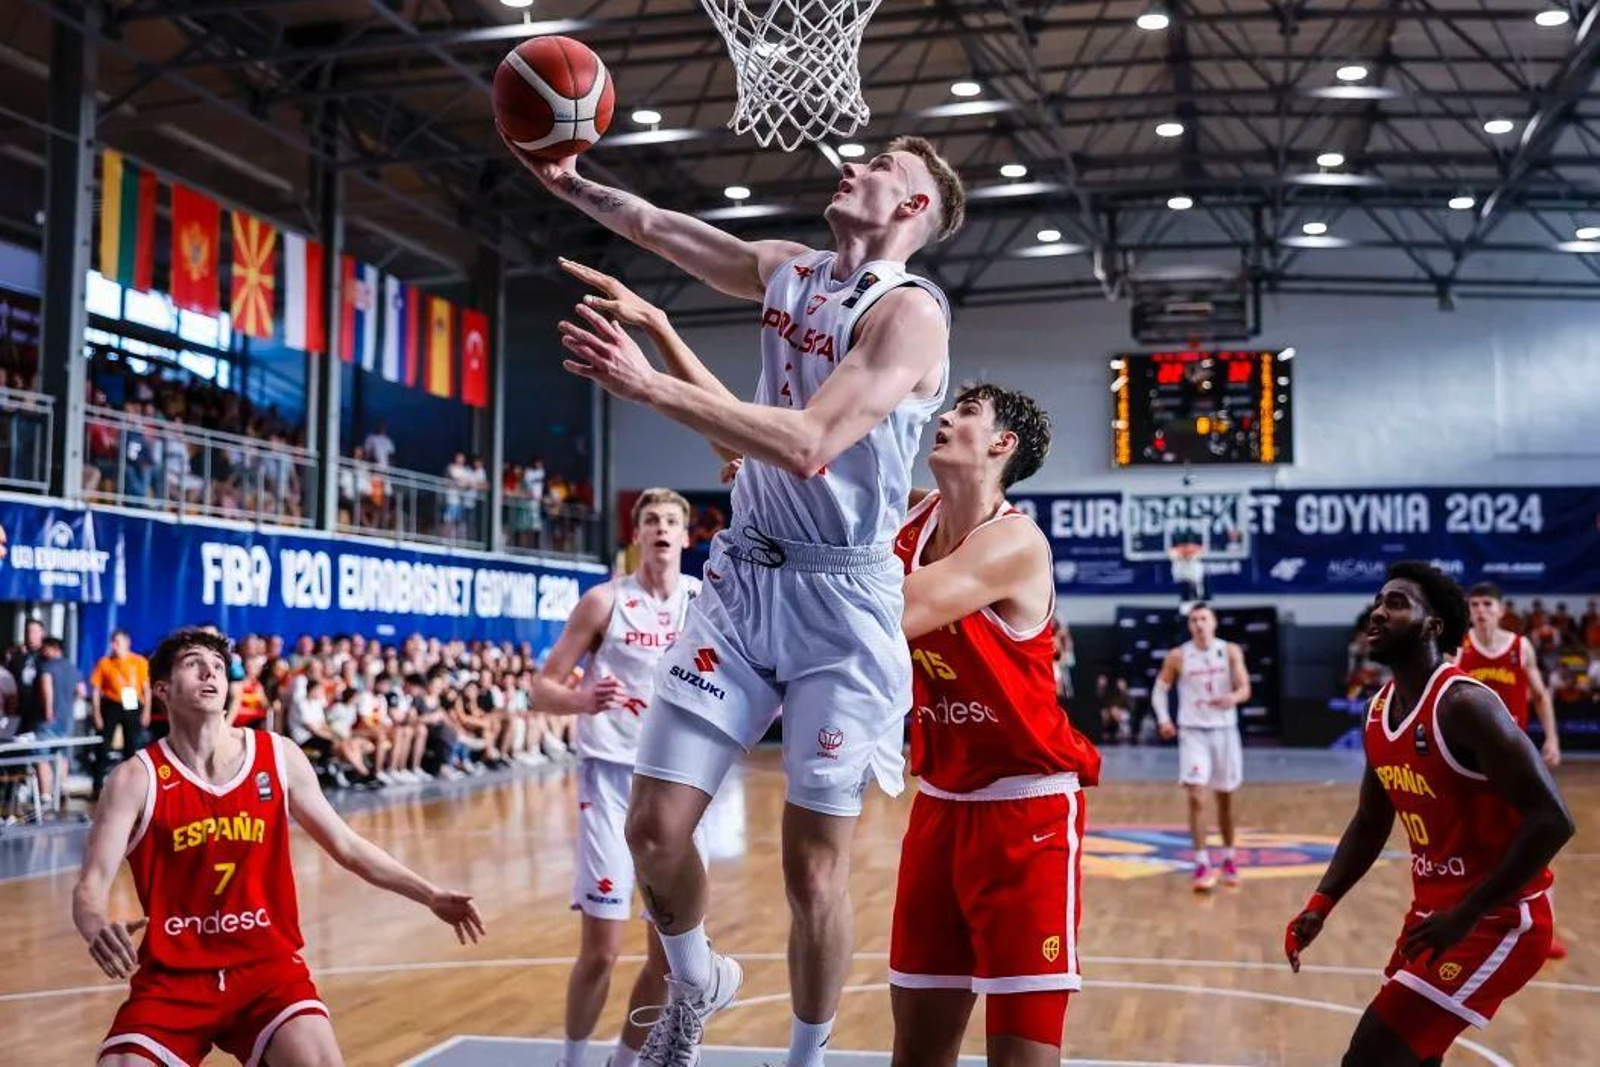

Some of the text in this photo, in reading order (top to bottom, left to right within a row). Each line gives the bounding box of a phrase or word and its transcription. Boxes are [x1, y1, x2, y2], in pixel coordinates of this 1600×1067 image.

[1296, 495, 1429, 534] GDYNIA
[1446, 493, 1544, 533] 2024
[201, 542, 272, 607] FIBA
[280, 548, 332, 610] U20
[338, 553, 474, 618] EUROBASKET
[912, 648, 957, 680] 15
[669, 665, 726, 700] SUZUKI
[172, 811, 265, 852] ESPAÑA
[1402, 811, 1429, 845] 10
[213, 863, 236, 895] 7
[164, 909, 272, 936] endesa
